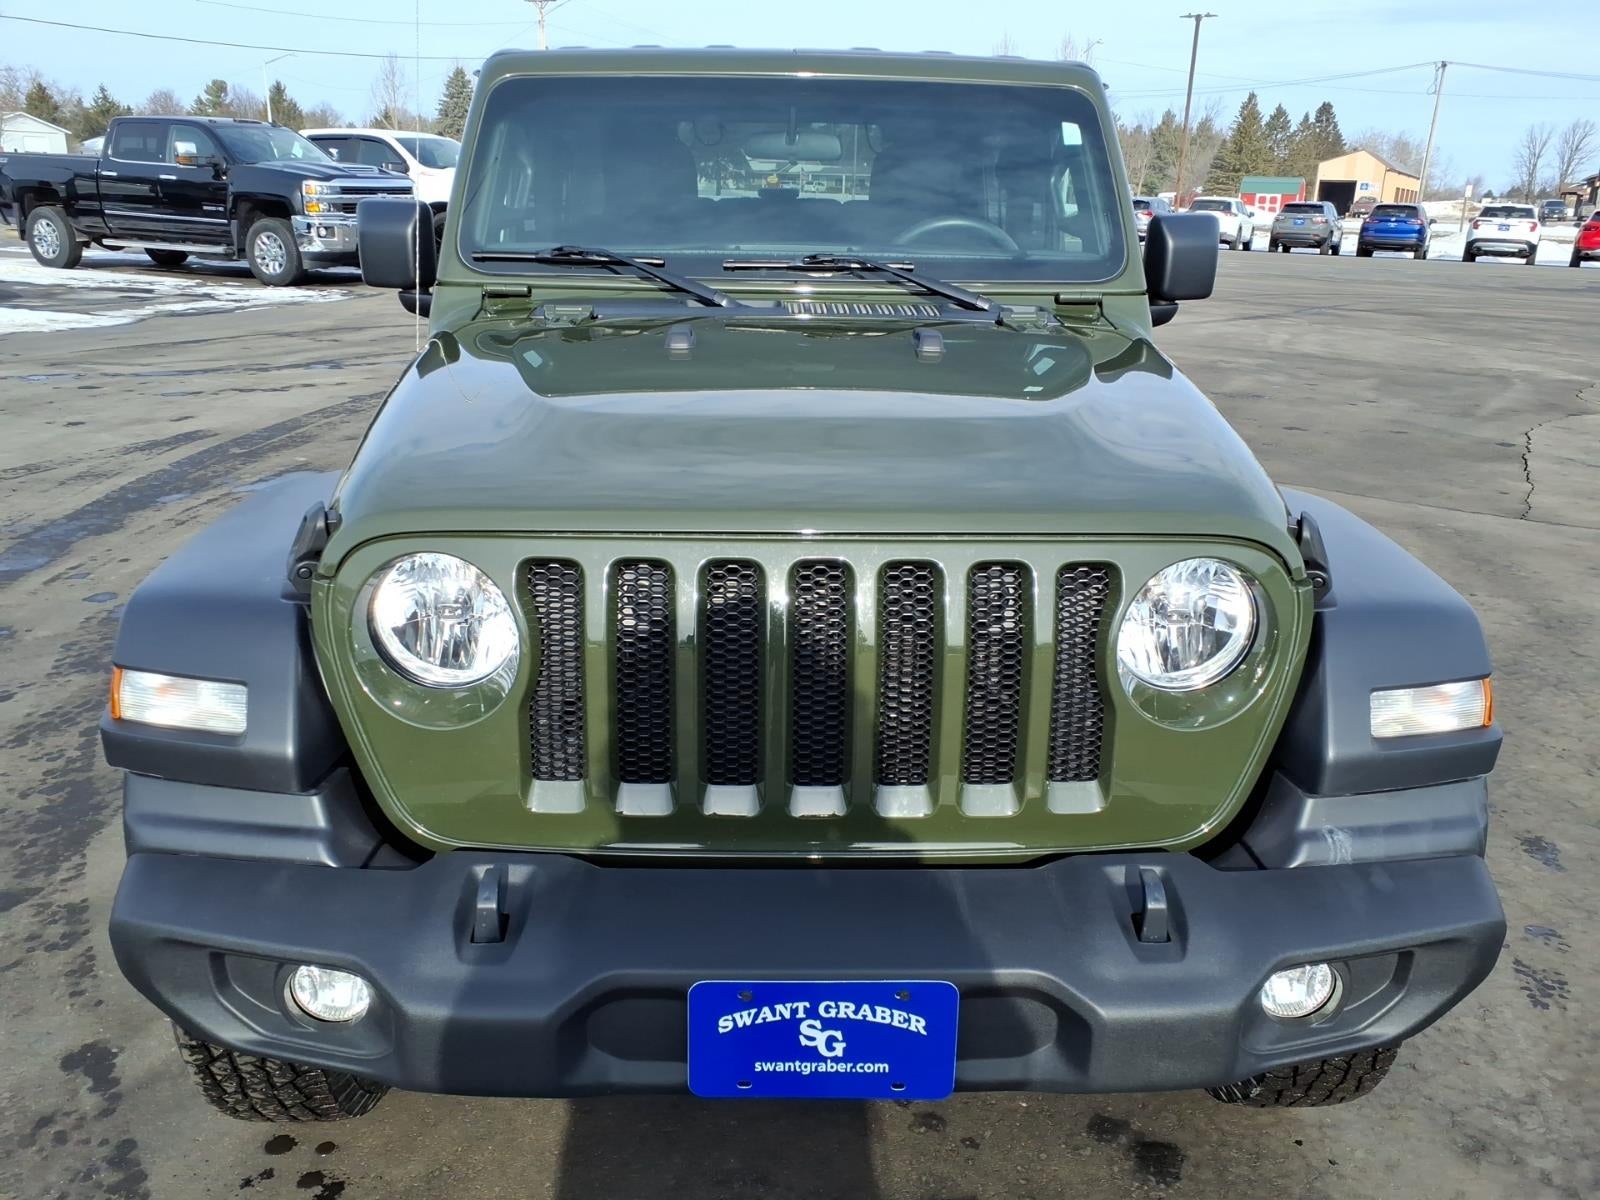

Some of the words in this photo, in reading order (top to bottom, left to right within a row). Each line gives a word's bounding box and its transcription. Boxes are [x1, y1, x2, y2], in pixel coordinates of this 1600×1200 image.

[718, 1002, 810, 1034] SWANT
[818, 1001, 927, 1035] GRABER
[799, 1019, 846, 1057] SG
[754, 1060, 889, 1075] swantgraber.com
